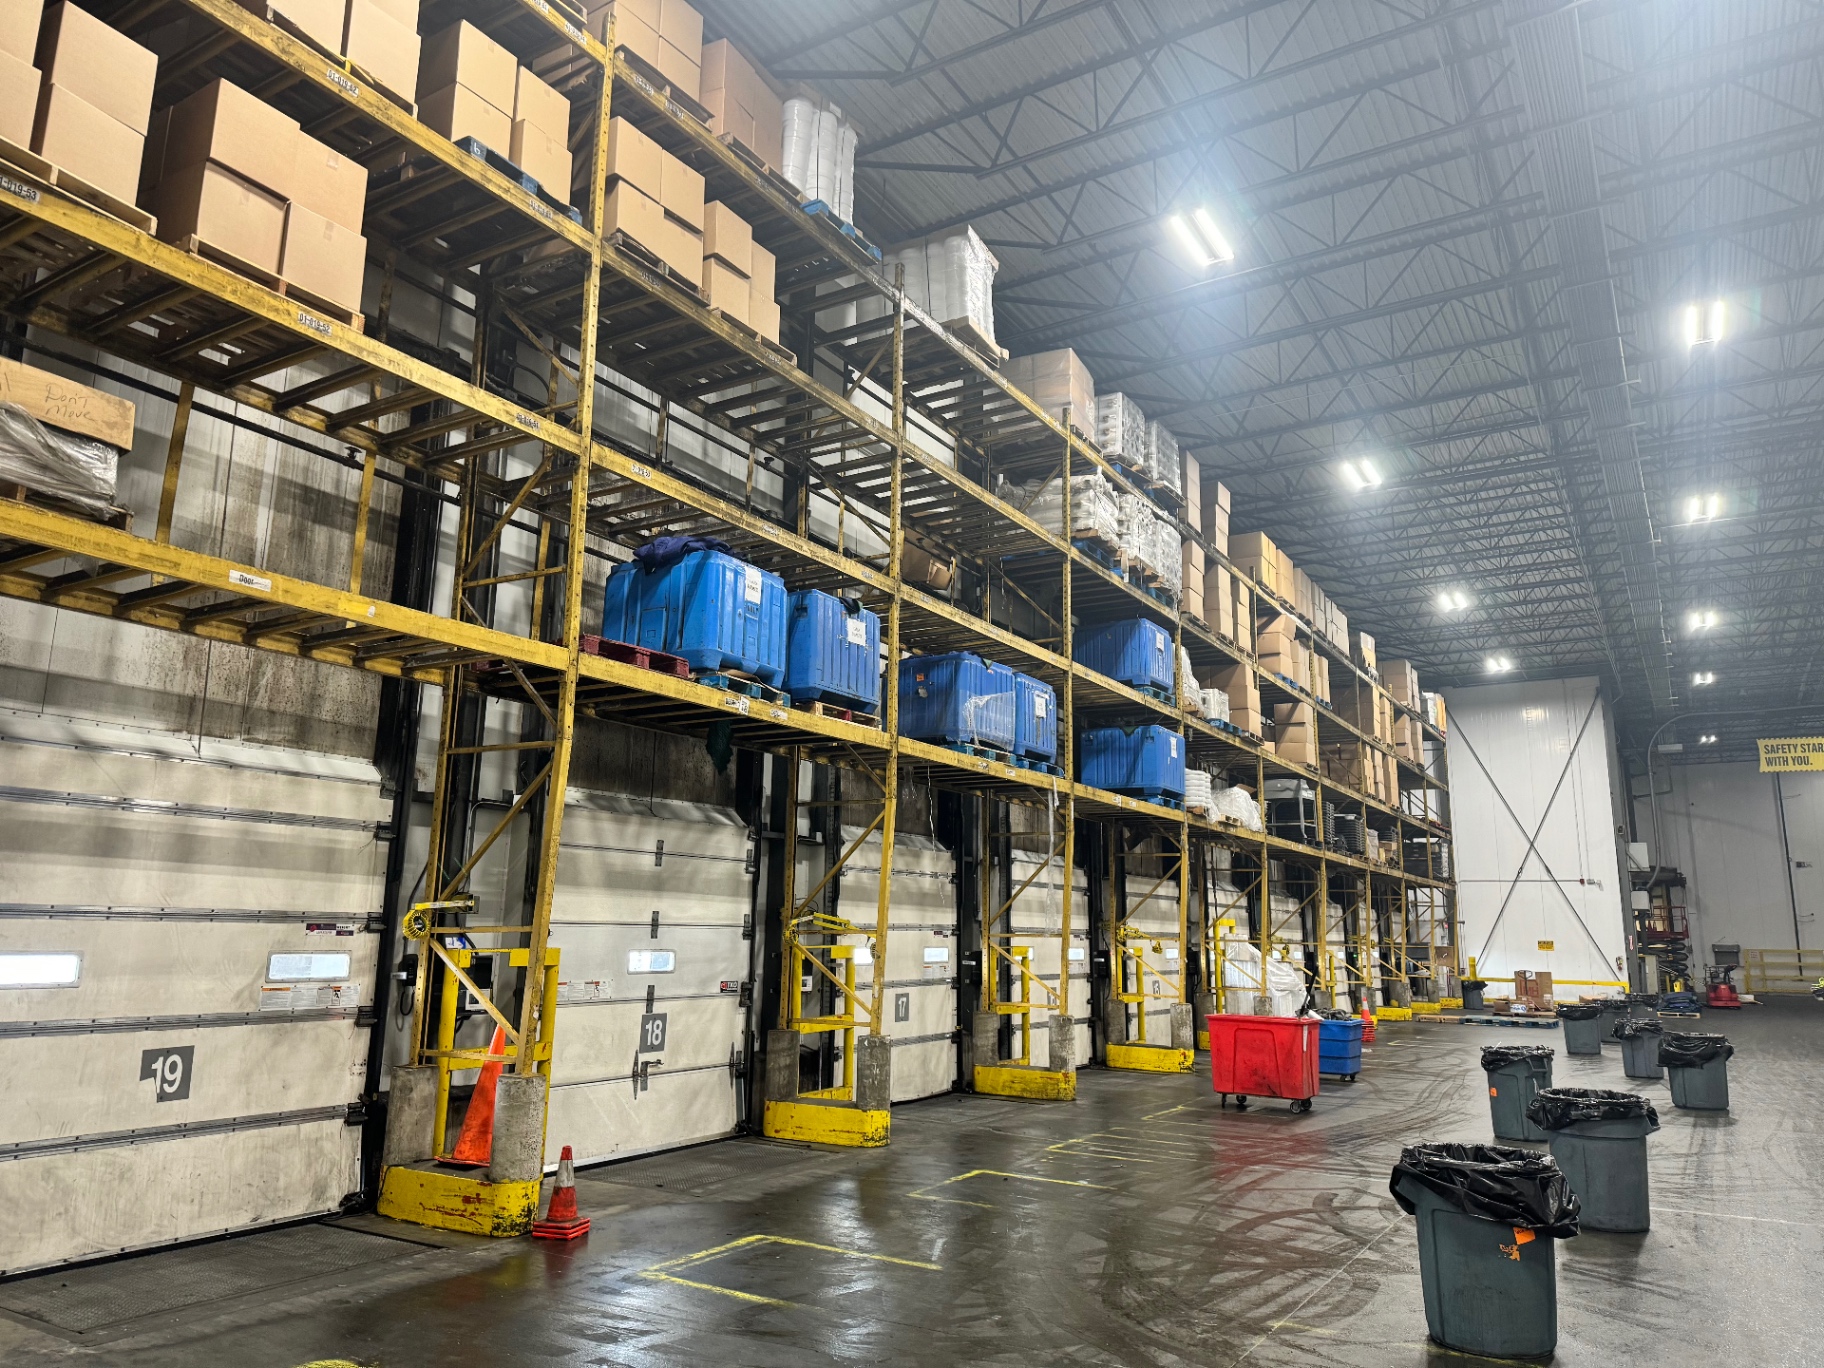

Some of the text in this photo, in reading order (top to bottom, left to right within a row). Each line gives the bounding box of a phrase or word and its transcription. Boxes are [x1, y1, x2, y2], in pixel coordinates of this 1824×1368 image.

[1763, 742, 1824, 754] SAFETY STAR
[1764, 755, 1813, 767] WITH YOU.
[898, 997, 907, 1017] 17
[645, 1019, 663, 1046] 18
[151, 1053, 183, 1094] 19
